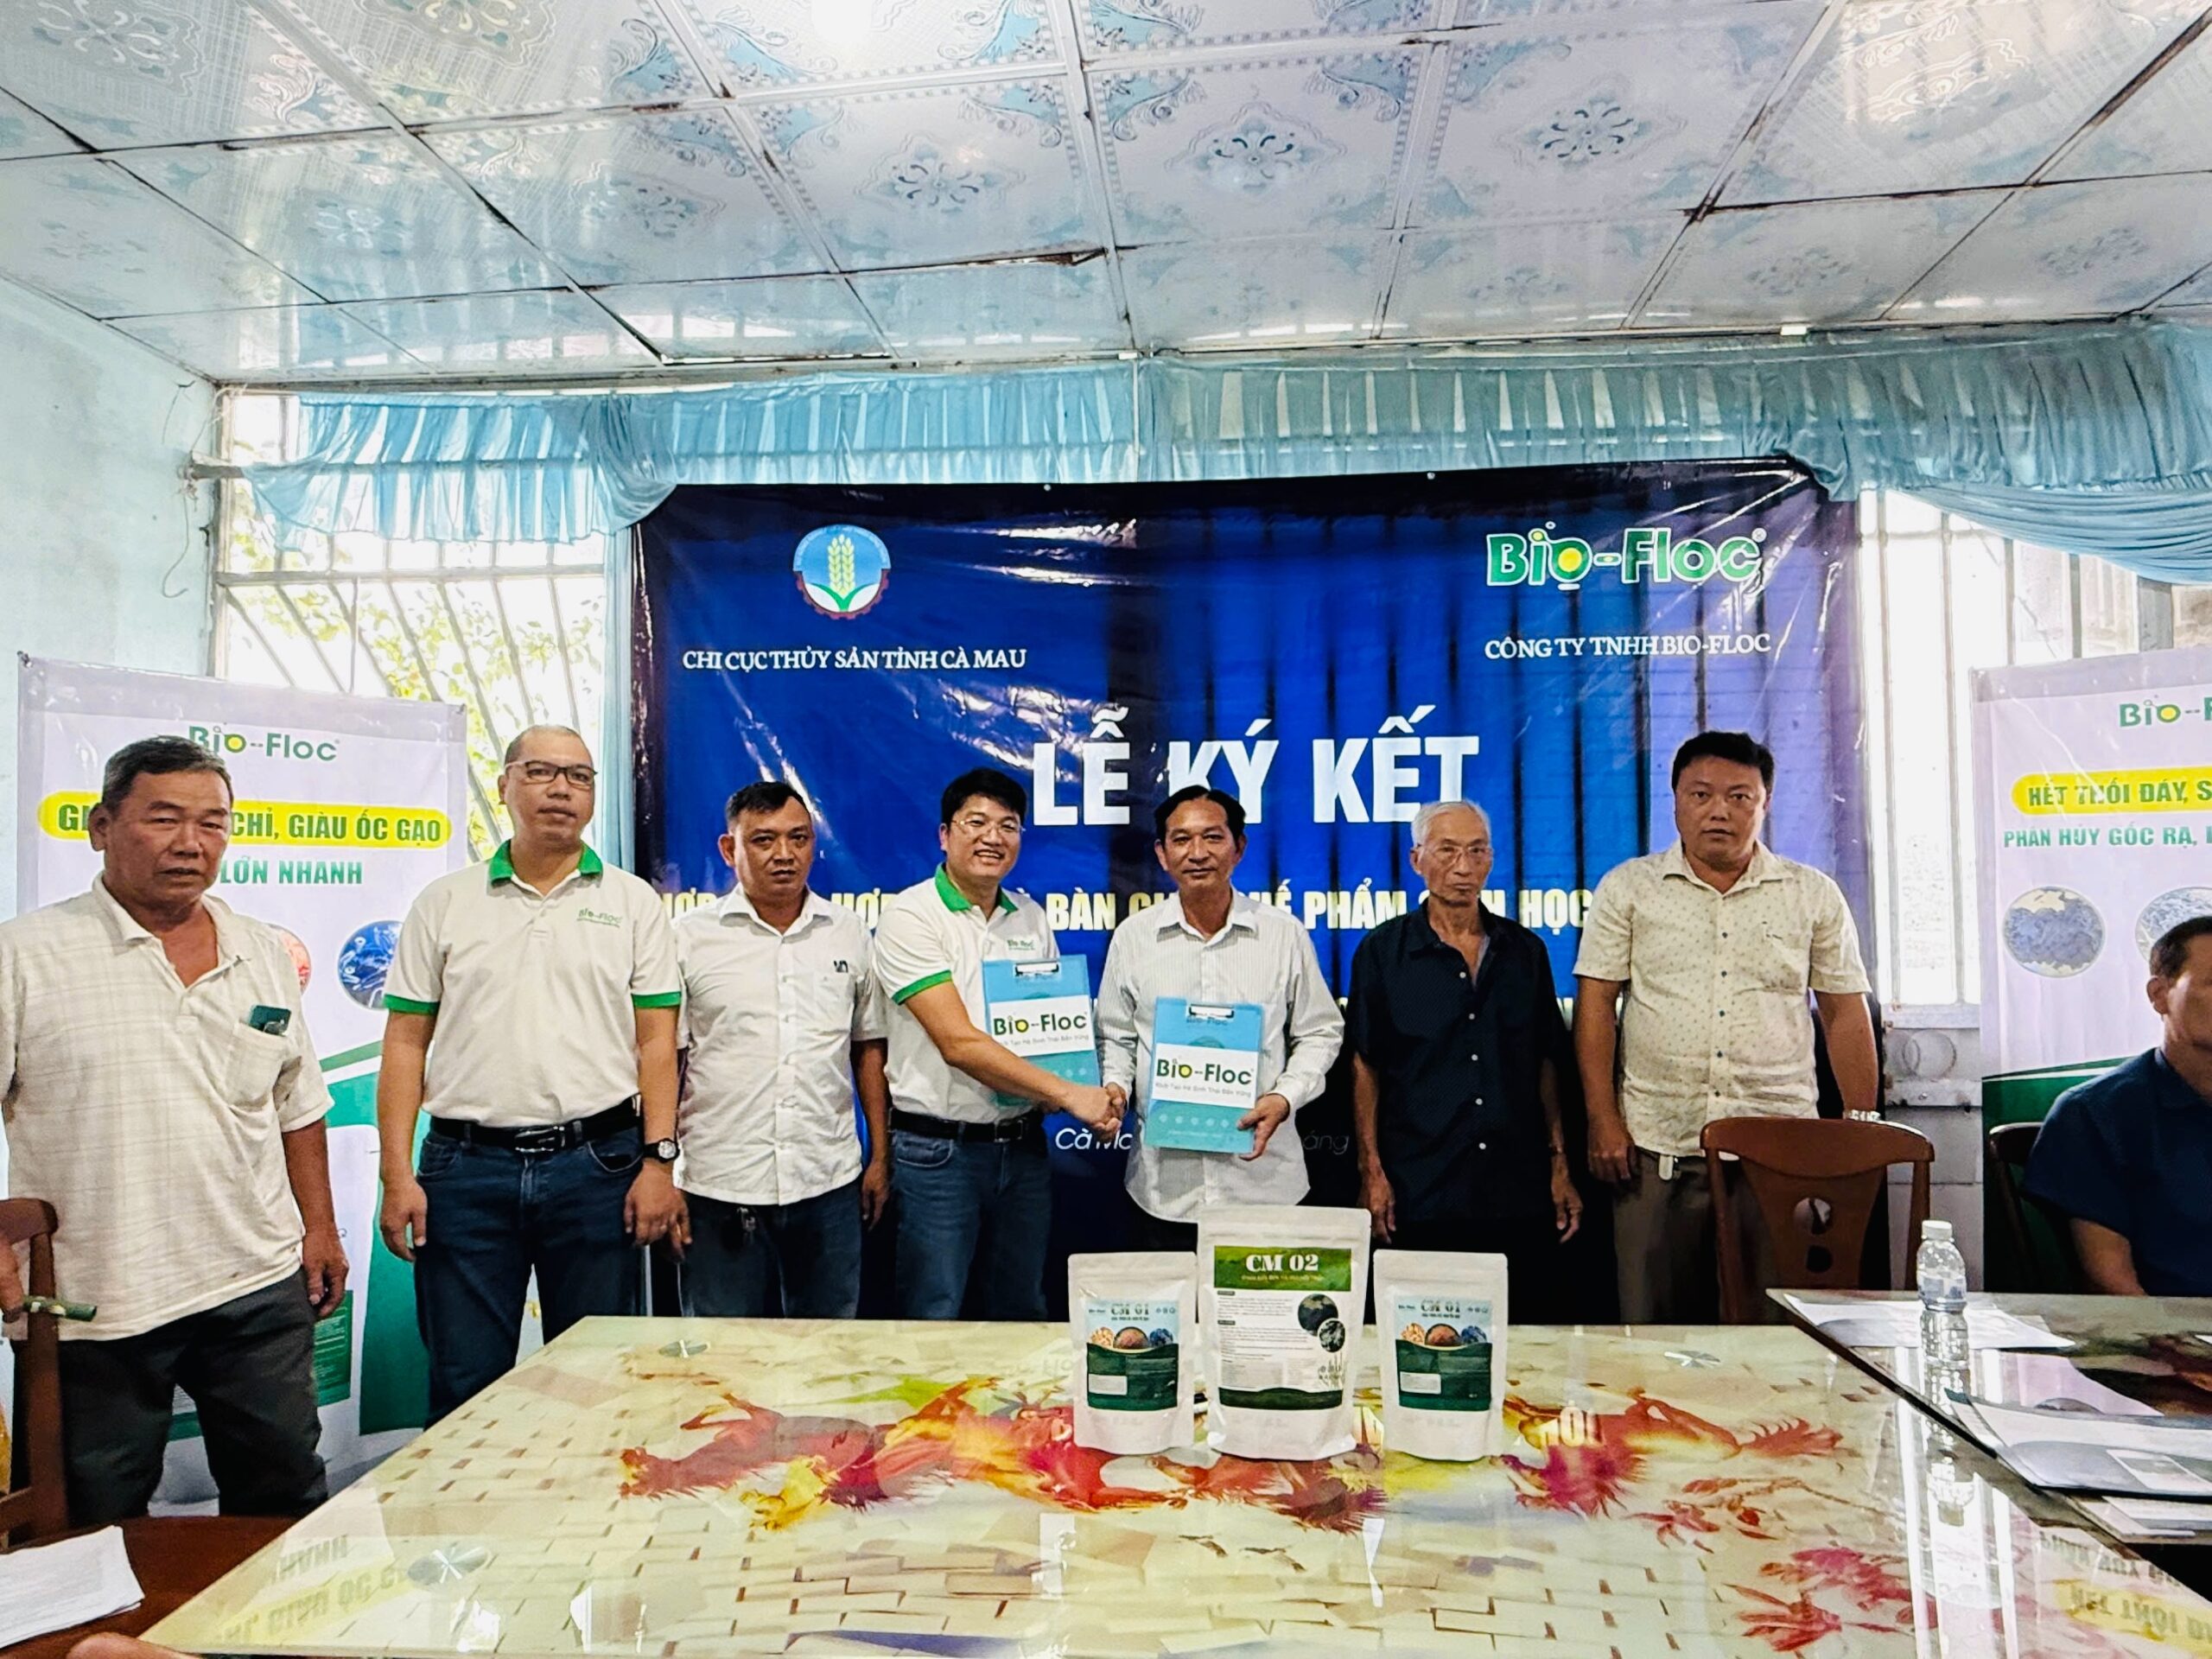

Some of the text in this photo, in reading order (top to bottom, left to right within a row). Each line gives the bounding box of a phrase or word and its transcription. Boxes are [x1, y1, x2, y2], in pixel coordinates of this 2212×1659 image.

[682, 645, 1027, 673] CHI CỤC THỦY SẢN TỈNH CÀ MAU
[1484, 633, 1771, 659] CÔNG TY TNHH BIO-FLOC
[1033, 704, 1480, 826] LỄ KÝ KẾT
[2028, 779, 2068, 806] HẾT
[289, 811, 346, 841] GIÀU
[356, 809, 389, 841] ỐC
[396, 817, 442, 847] GẠO
[2058, 823, 2101, 846] HỦY
[2108, 821, 2155, 846] GỐC
[278, 860, 363, 885] NHANH
[1046, 887, 1117, 931] BÀN
[1303, 877, 1407, 930] PHẨM
[1519, 888, 1593, 936] HỌC
[1054, 1127, 1093, 1150] Cà
[1245, 1254, 1319, 1273] CM 02
